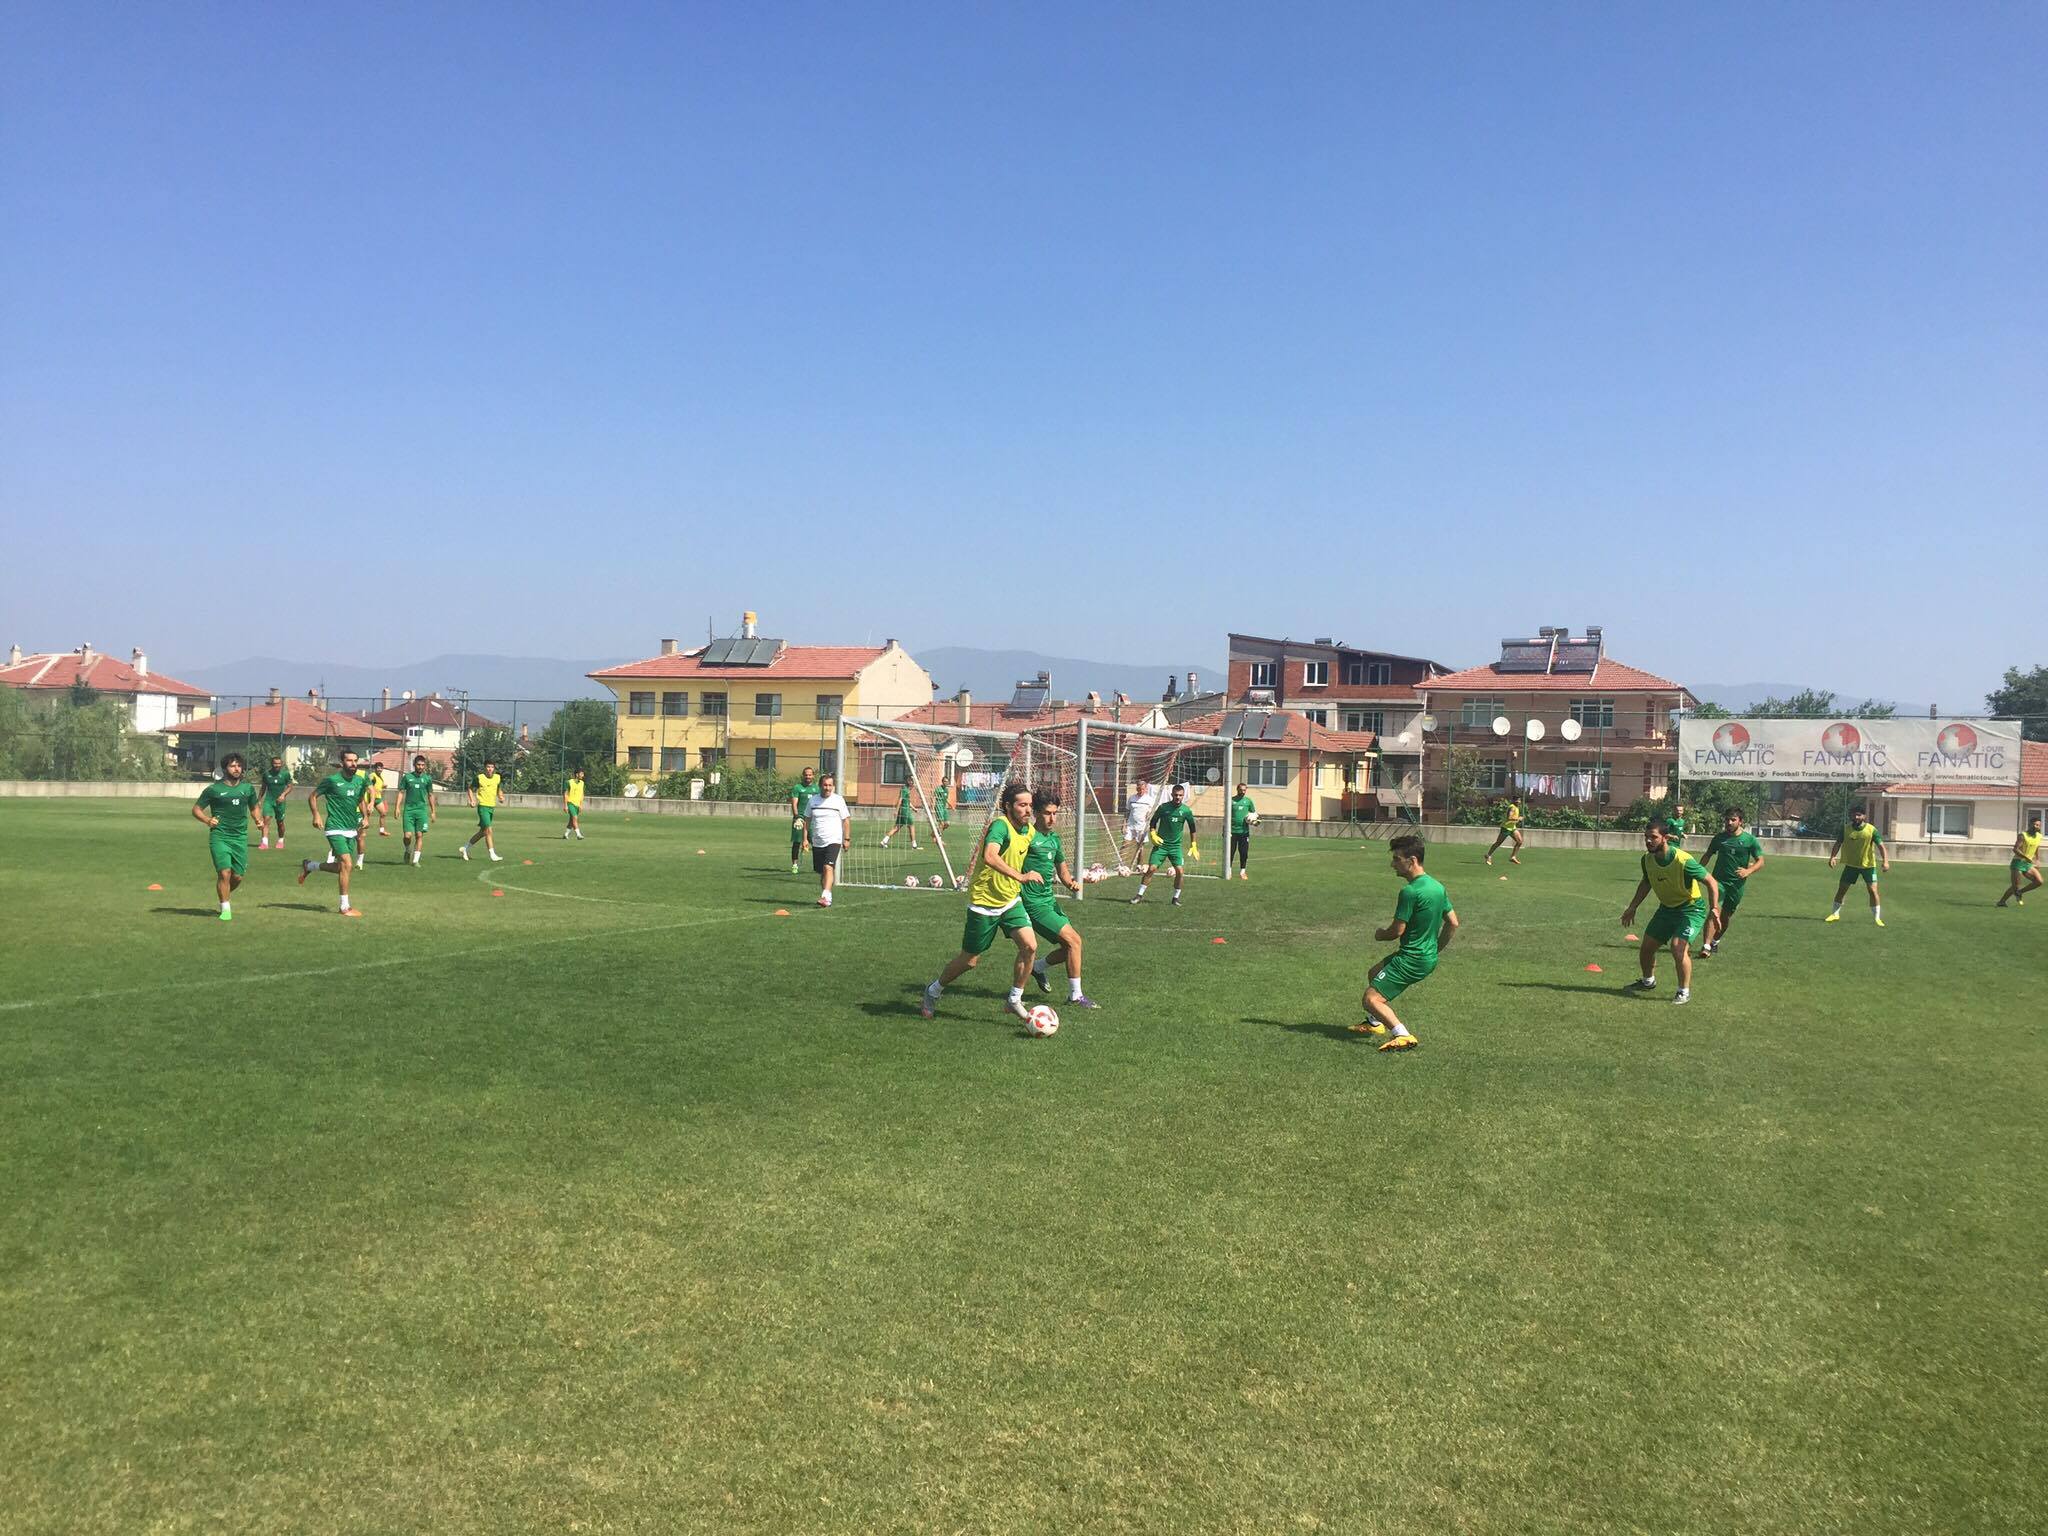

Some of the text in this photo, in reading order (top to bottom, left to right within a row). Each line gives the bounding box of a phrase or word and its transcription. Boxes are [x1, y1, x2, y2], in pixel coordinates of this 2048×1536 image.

[1695, 749, 1775, 765] FANATIC
[1803, 750, 1887, 767] FANATIC
[1918, 751, 2004, 769] FANATIC
